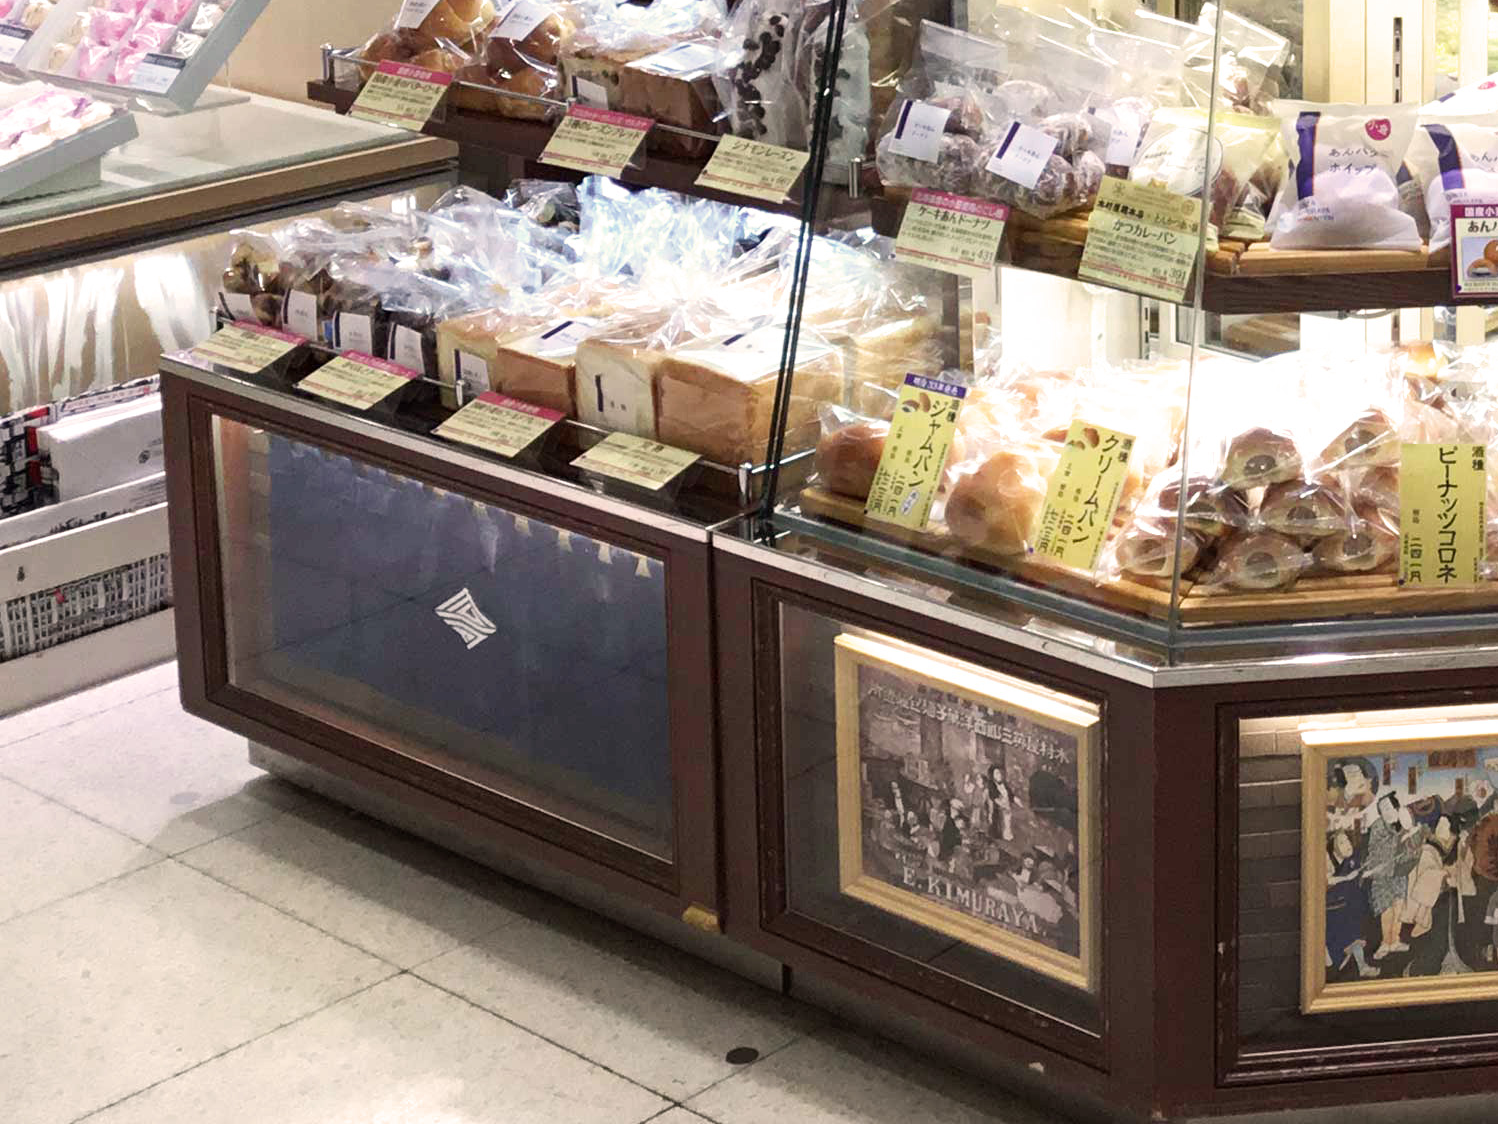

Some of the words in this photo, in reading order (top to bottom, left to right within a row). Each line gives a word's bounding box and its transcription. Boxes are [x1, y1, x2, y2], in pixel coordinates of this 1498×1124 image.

[916, 205, 992, 230] ケーキあんドーナツ
[1111, 219, 1178, 245] かつカレーパン
[907, 399, 950, 489] ジャムパン
[1471, 446, 1485, 471] 酒種
[1071, 434, 1119, 545] クリームパン
[1436, 446, 1459, 584] ピーナッツコロネ
[1409, 537, 1423, 584] 二四一円
